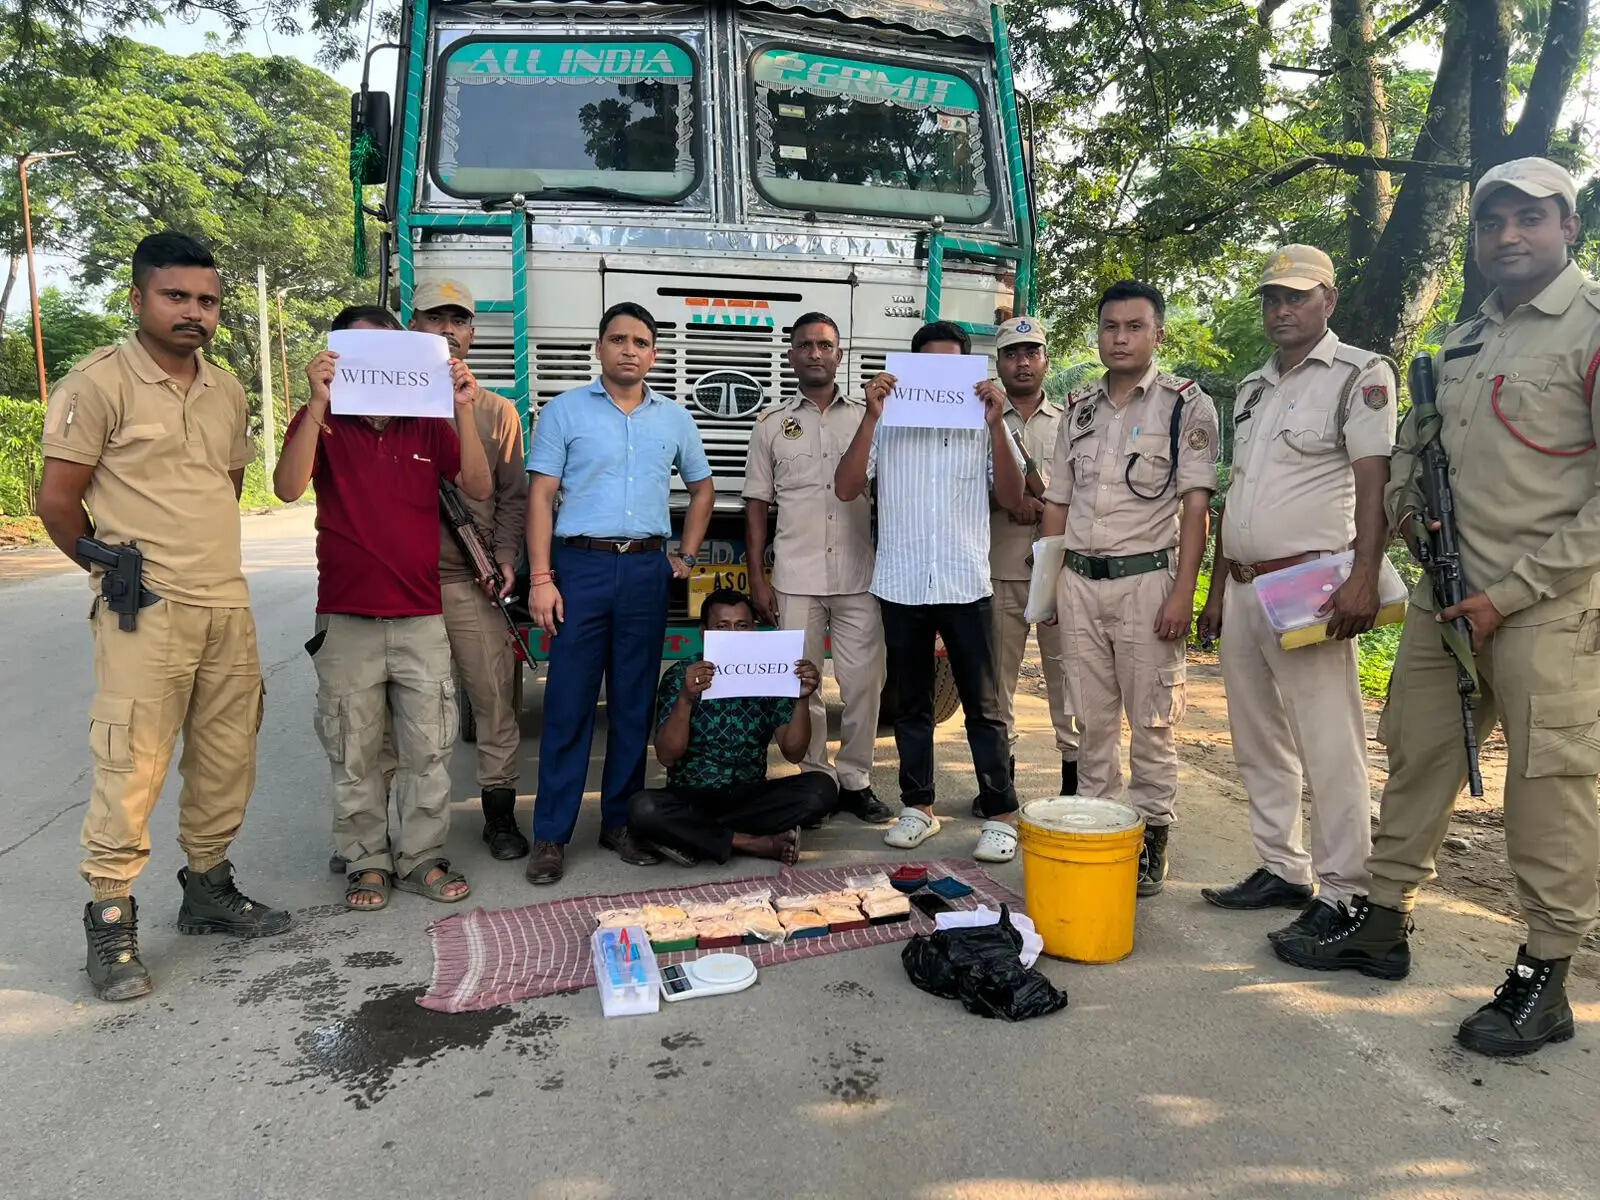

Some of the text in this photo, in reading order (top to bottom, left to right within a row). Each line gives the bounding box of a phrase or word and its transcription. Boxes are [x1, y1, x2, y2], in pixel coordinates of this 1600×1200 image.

[467, 49, 675, 74] ALL INDIA
[773, 56, 956, 103] PERMIT
[892, 295, 915, 304] TATA
[684, 298, 775, 326] TATA
[341, 368, 430, 387] WITNESS
[893, 387, 965, 405] WITNESS
[715, 662, 788, 676] ACCUSED
